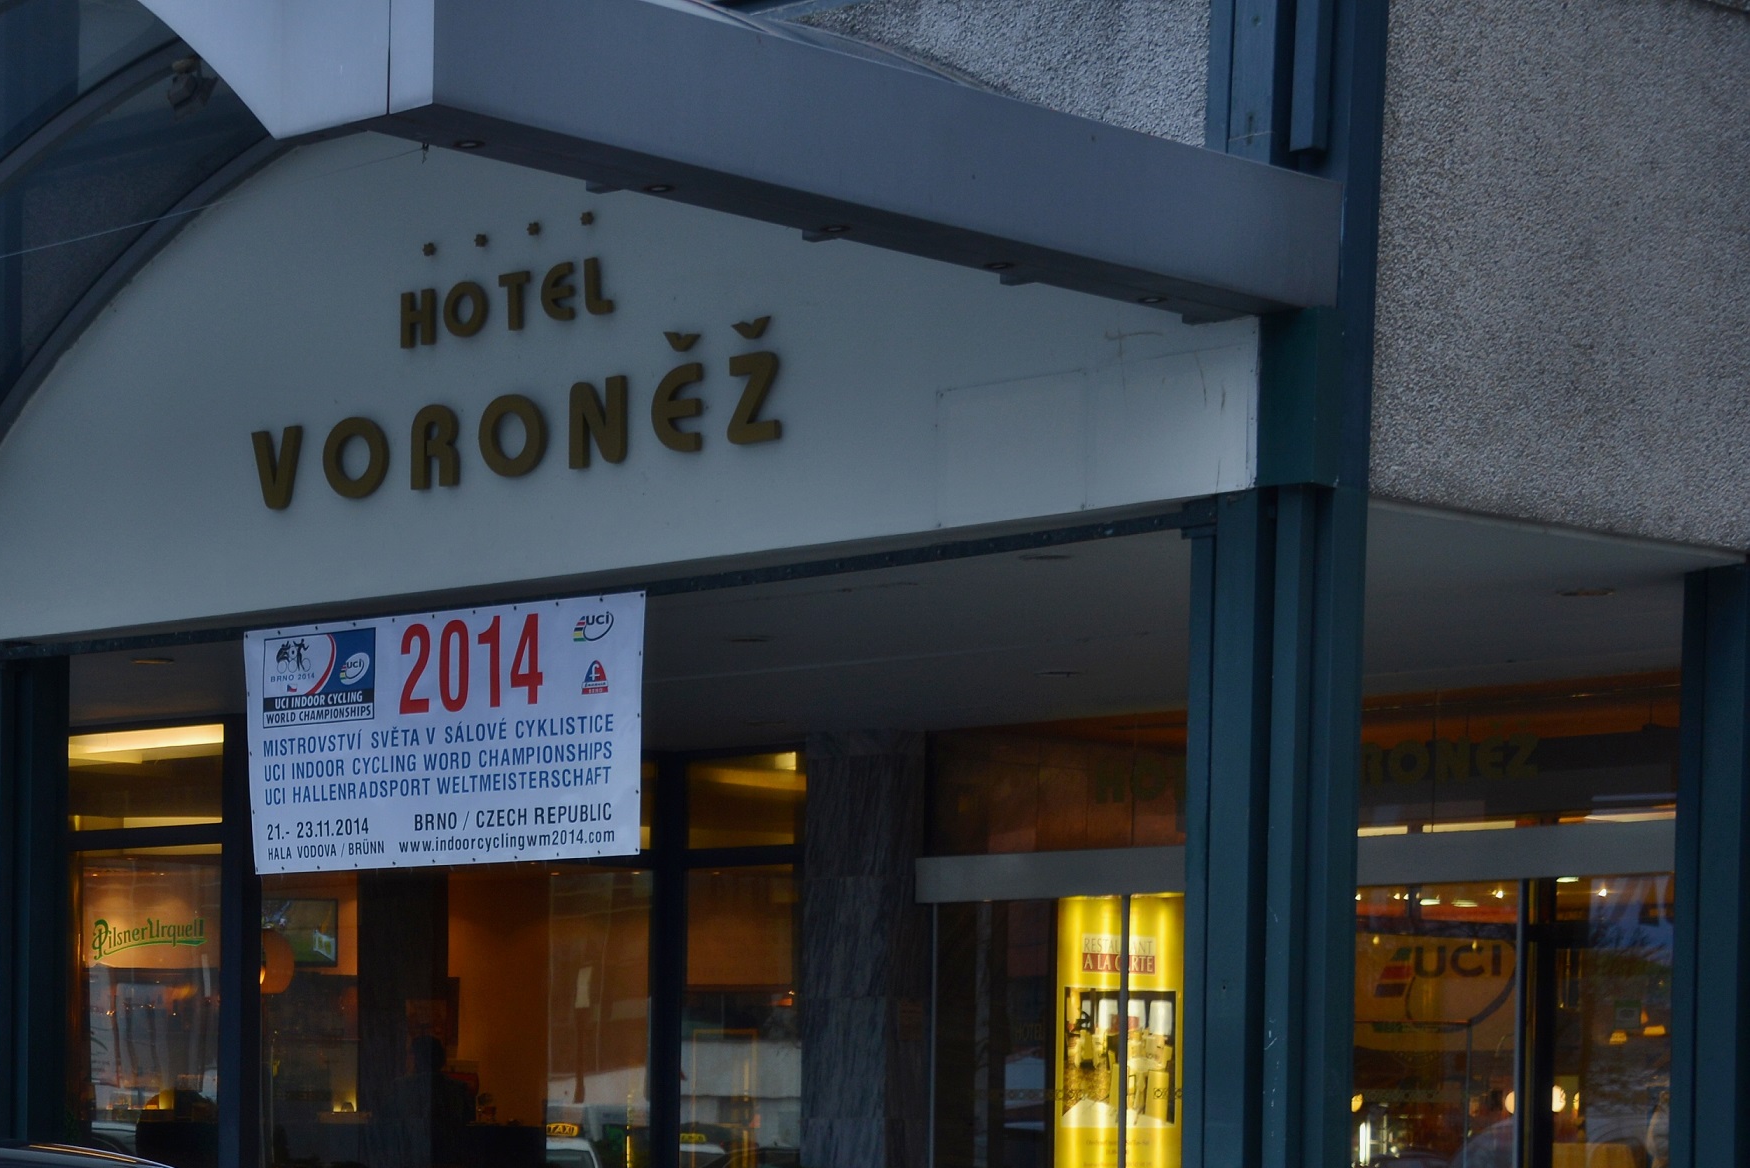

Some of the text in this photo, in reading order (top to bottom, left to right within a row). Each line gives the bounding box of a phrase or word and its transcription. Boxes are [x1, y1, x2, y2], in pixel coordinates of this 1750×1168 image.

[400, 256, 614, 349] HOTEL
[251, 315, 782, 511] VORONĚŽ
[270, 672, 315, 682] BRNO 2014
[399, 613, 543, 715] 2014
[274, 690, 363, 710] UCI INDOOR CYCLING
[266, 705, 371, 725] WORLD CHAMPIONSHIPS
[263, 713, 614, 757] MISTROVSTVÍ SVĚTA V SÁLOVÉ CYKLISTICE
[264, 741, 613, 782] UCI INDOOR CYCLING WORD CHAMPIONSHIPS
[265, 766, 612, 806] UCI HALLENRADSPORT WELTMEISTERSCHAFT
[267, 817, 369, 841] 21.- 23.11.2014
[414, 802, 612, 831] BRNO / CZECH REPUBLIC
[268, 847, 292, 861] HALA
[297, 843, 337, 859] VODOVA
[348, 838, 385, 856] BRÜNN
[399, 829, 615, 853] www.indoorcyclingwm2014.com
[92, 918, 205, 960] Pilsner Urquell
[1083, 937, 1153, 954] RESTAUANT
[1083, 953, 1154, 972] A LA CRTE
